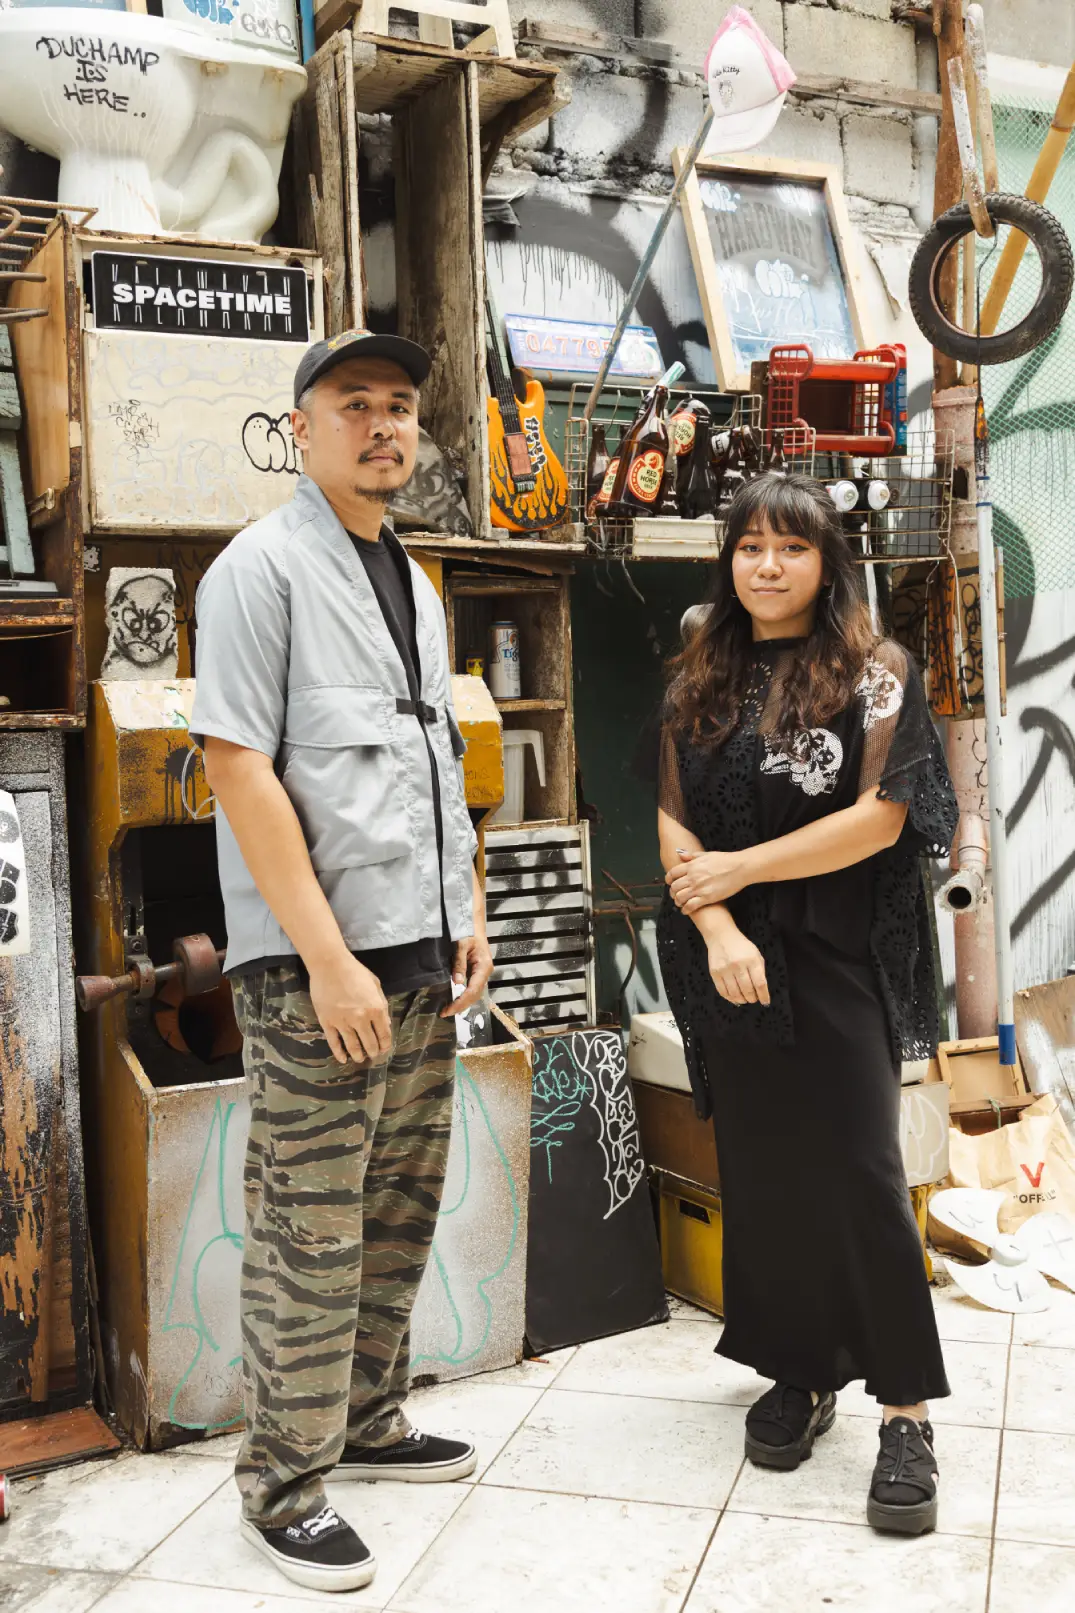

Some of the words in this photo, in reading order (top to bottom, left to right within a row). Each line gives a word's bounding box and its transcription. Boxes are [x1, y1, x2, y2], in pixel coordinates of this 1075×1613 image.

[36, 36, 160, 76] DUCHAMP
[75, 59, 109, 83] IS
[112, 283, 292, 316] SPACETIME
[640, 475, 658, 486] HORSE
[646, 469, 658, 478] RED
